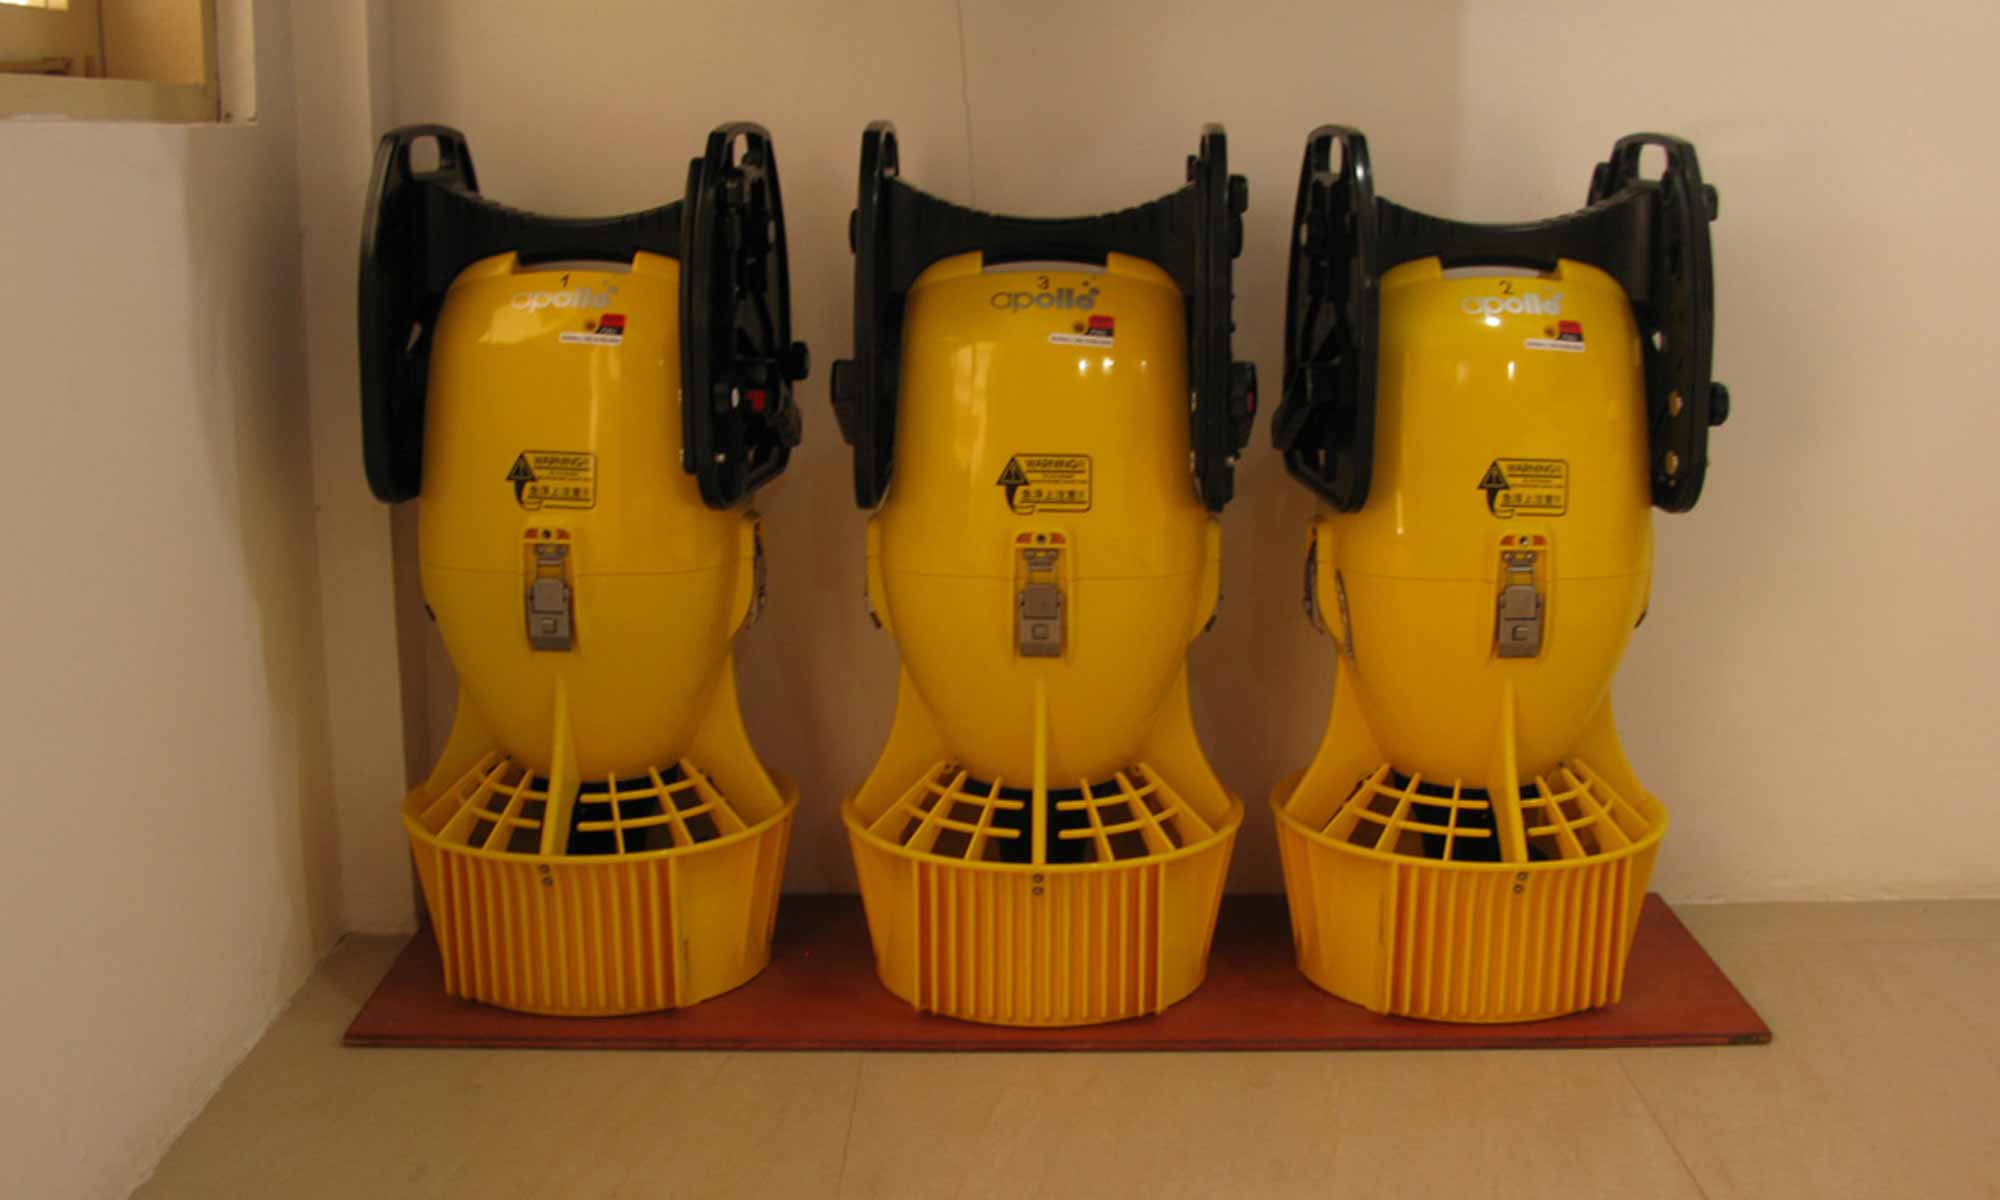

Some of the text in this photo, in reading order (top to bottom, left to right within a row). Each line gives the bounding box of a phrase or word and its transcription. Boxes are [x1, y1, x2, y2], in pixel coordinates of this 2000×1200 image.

[560, 273, 570, 289] 1
[1036, 275, 1051, 290] 3
[1499, 280, 1516, 295] 2
[511, 287, 611, 313] apollo
[990, 287, 1095, 313] apollo
[1461, 293, 1562, 317] apollo
